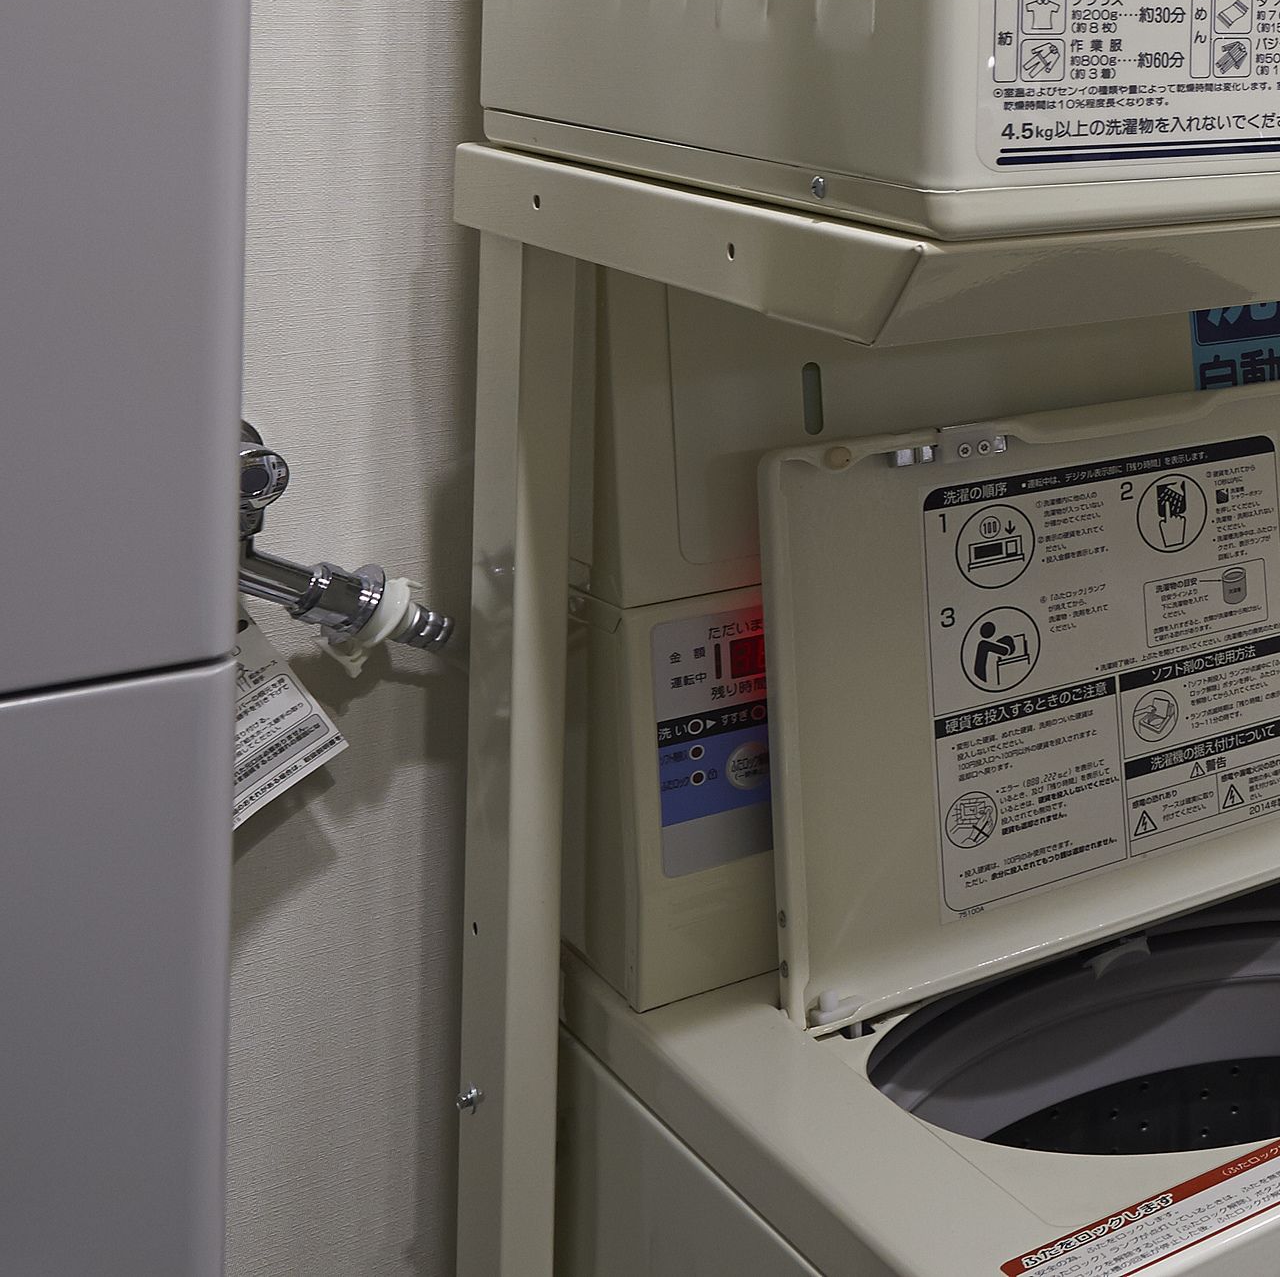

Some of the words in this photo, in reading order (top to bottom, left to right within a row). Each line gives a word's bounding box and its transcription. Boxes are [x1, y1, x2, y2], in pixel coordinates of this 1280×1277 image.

[943, 482, 1008, 505] 洗濯の順序
[1120, 481, 1134, 501] 2
[939, 513, 947, 533] 1
[940, 607, 956, 628] 3
[1151, 645, 1257, 682] ソフト剤のご使用方法
[670, 672, 708, 690] 運転中
[1150, 724, 1276, 771] 洗濯機の据え付けについて
[1206, 756, 1227, 771] 警告
[1021, 1193, 1173, 1268] ふたをロックします
